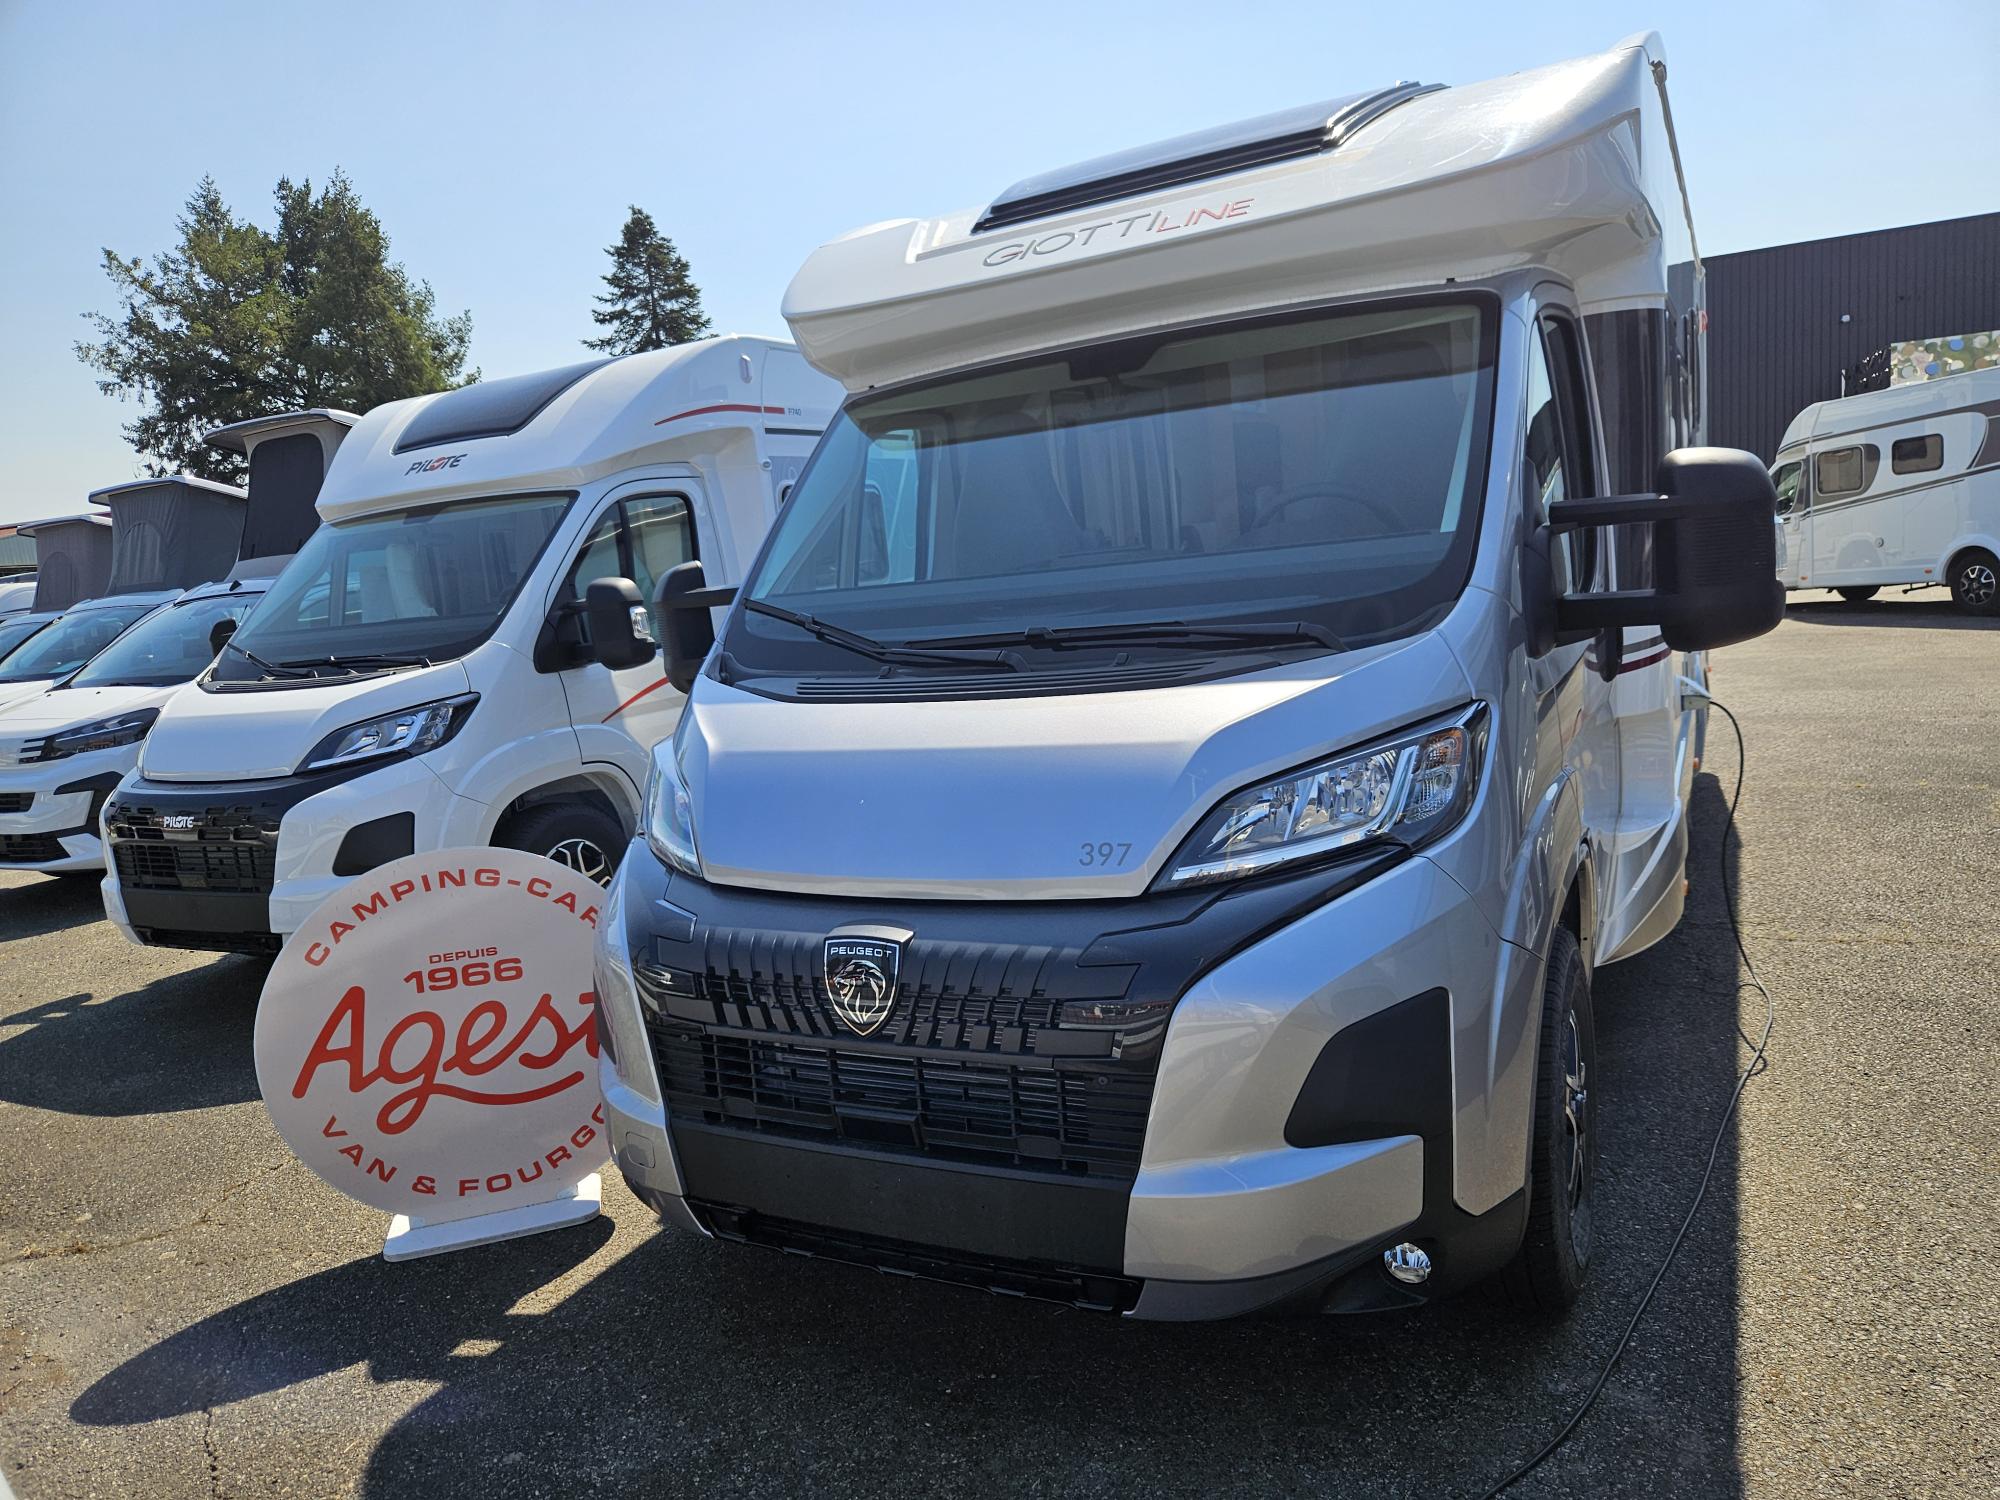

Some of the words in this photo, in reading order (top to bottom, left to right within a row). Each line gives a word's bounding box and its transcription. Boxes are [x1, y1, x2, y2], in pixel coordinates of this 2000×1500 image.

[982, 197, 1256, 268] GIOTTILINE
[404, 453, 468, 477] PILOTE
[163, 815, 195, 829] PILOTE
[1079, 842, 1133, 867] 397
[428, 946, 498, 964] DEPUIS
[830, 946, 893, 958] PEUGEOT
[403, 957, 525, 994] 1966
[322, 1114, 398, 1184] VAN
[412, 1174, 438, 1197] &
